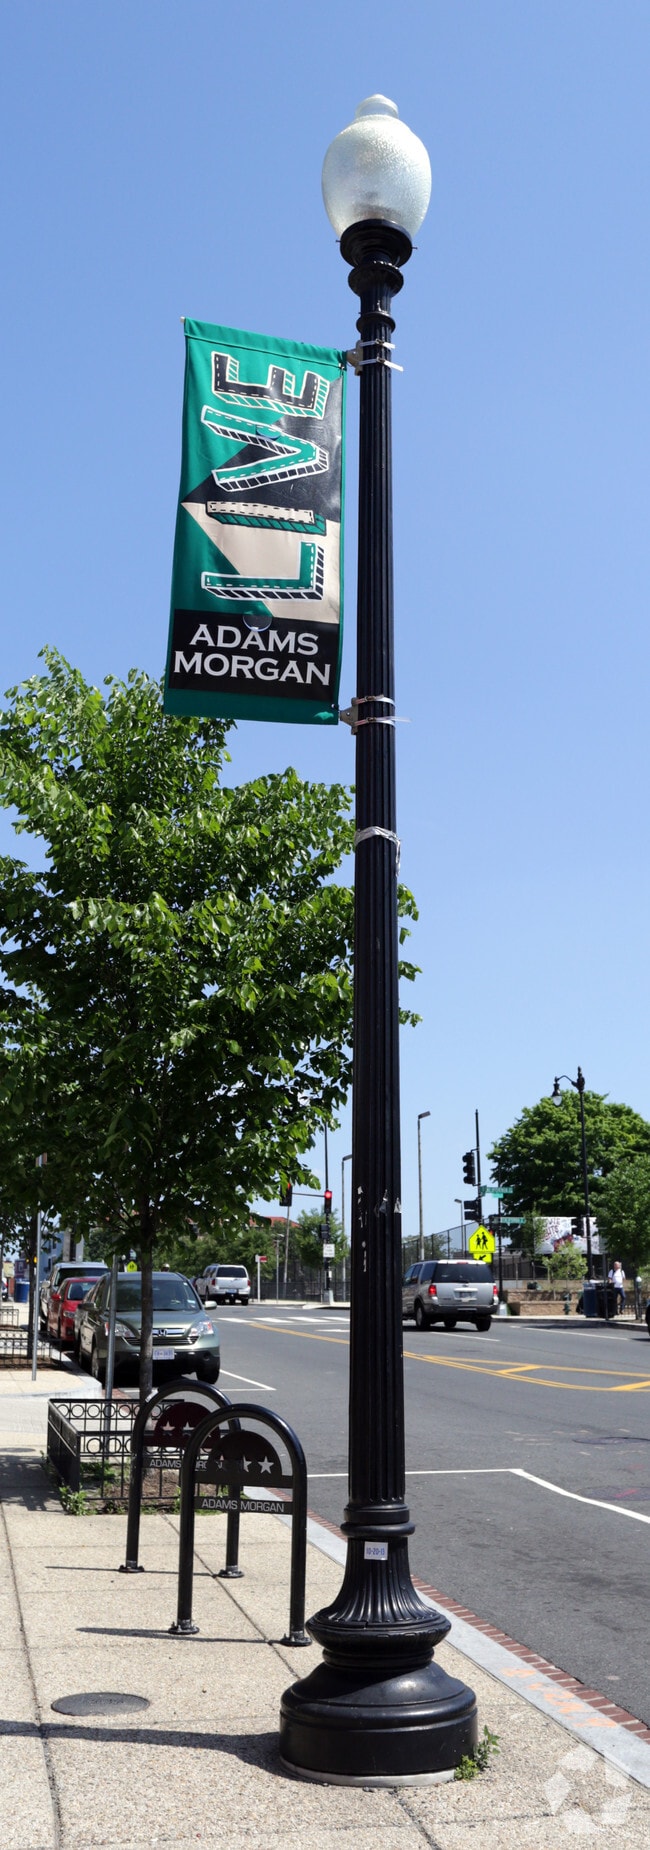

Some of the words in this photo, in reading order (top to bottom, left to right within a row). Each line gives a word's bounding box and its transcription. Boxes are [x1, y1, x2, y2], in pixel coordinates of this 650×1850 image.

[201, 351, 330, 600] LIVE
[189, 623, 319, 656] ADAMS
[174, 651, 331, 686] MORGAN
[149, 1459, 182, 1468] ADAMS
[201, 1498, 238, 1510] ADAMS
[240, 1501, 285, 1513] MORGAN
